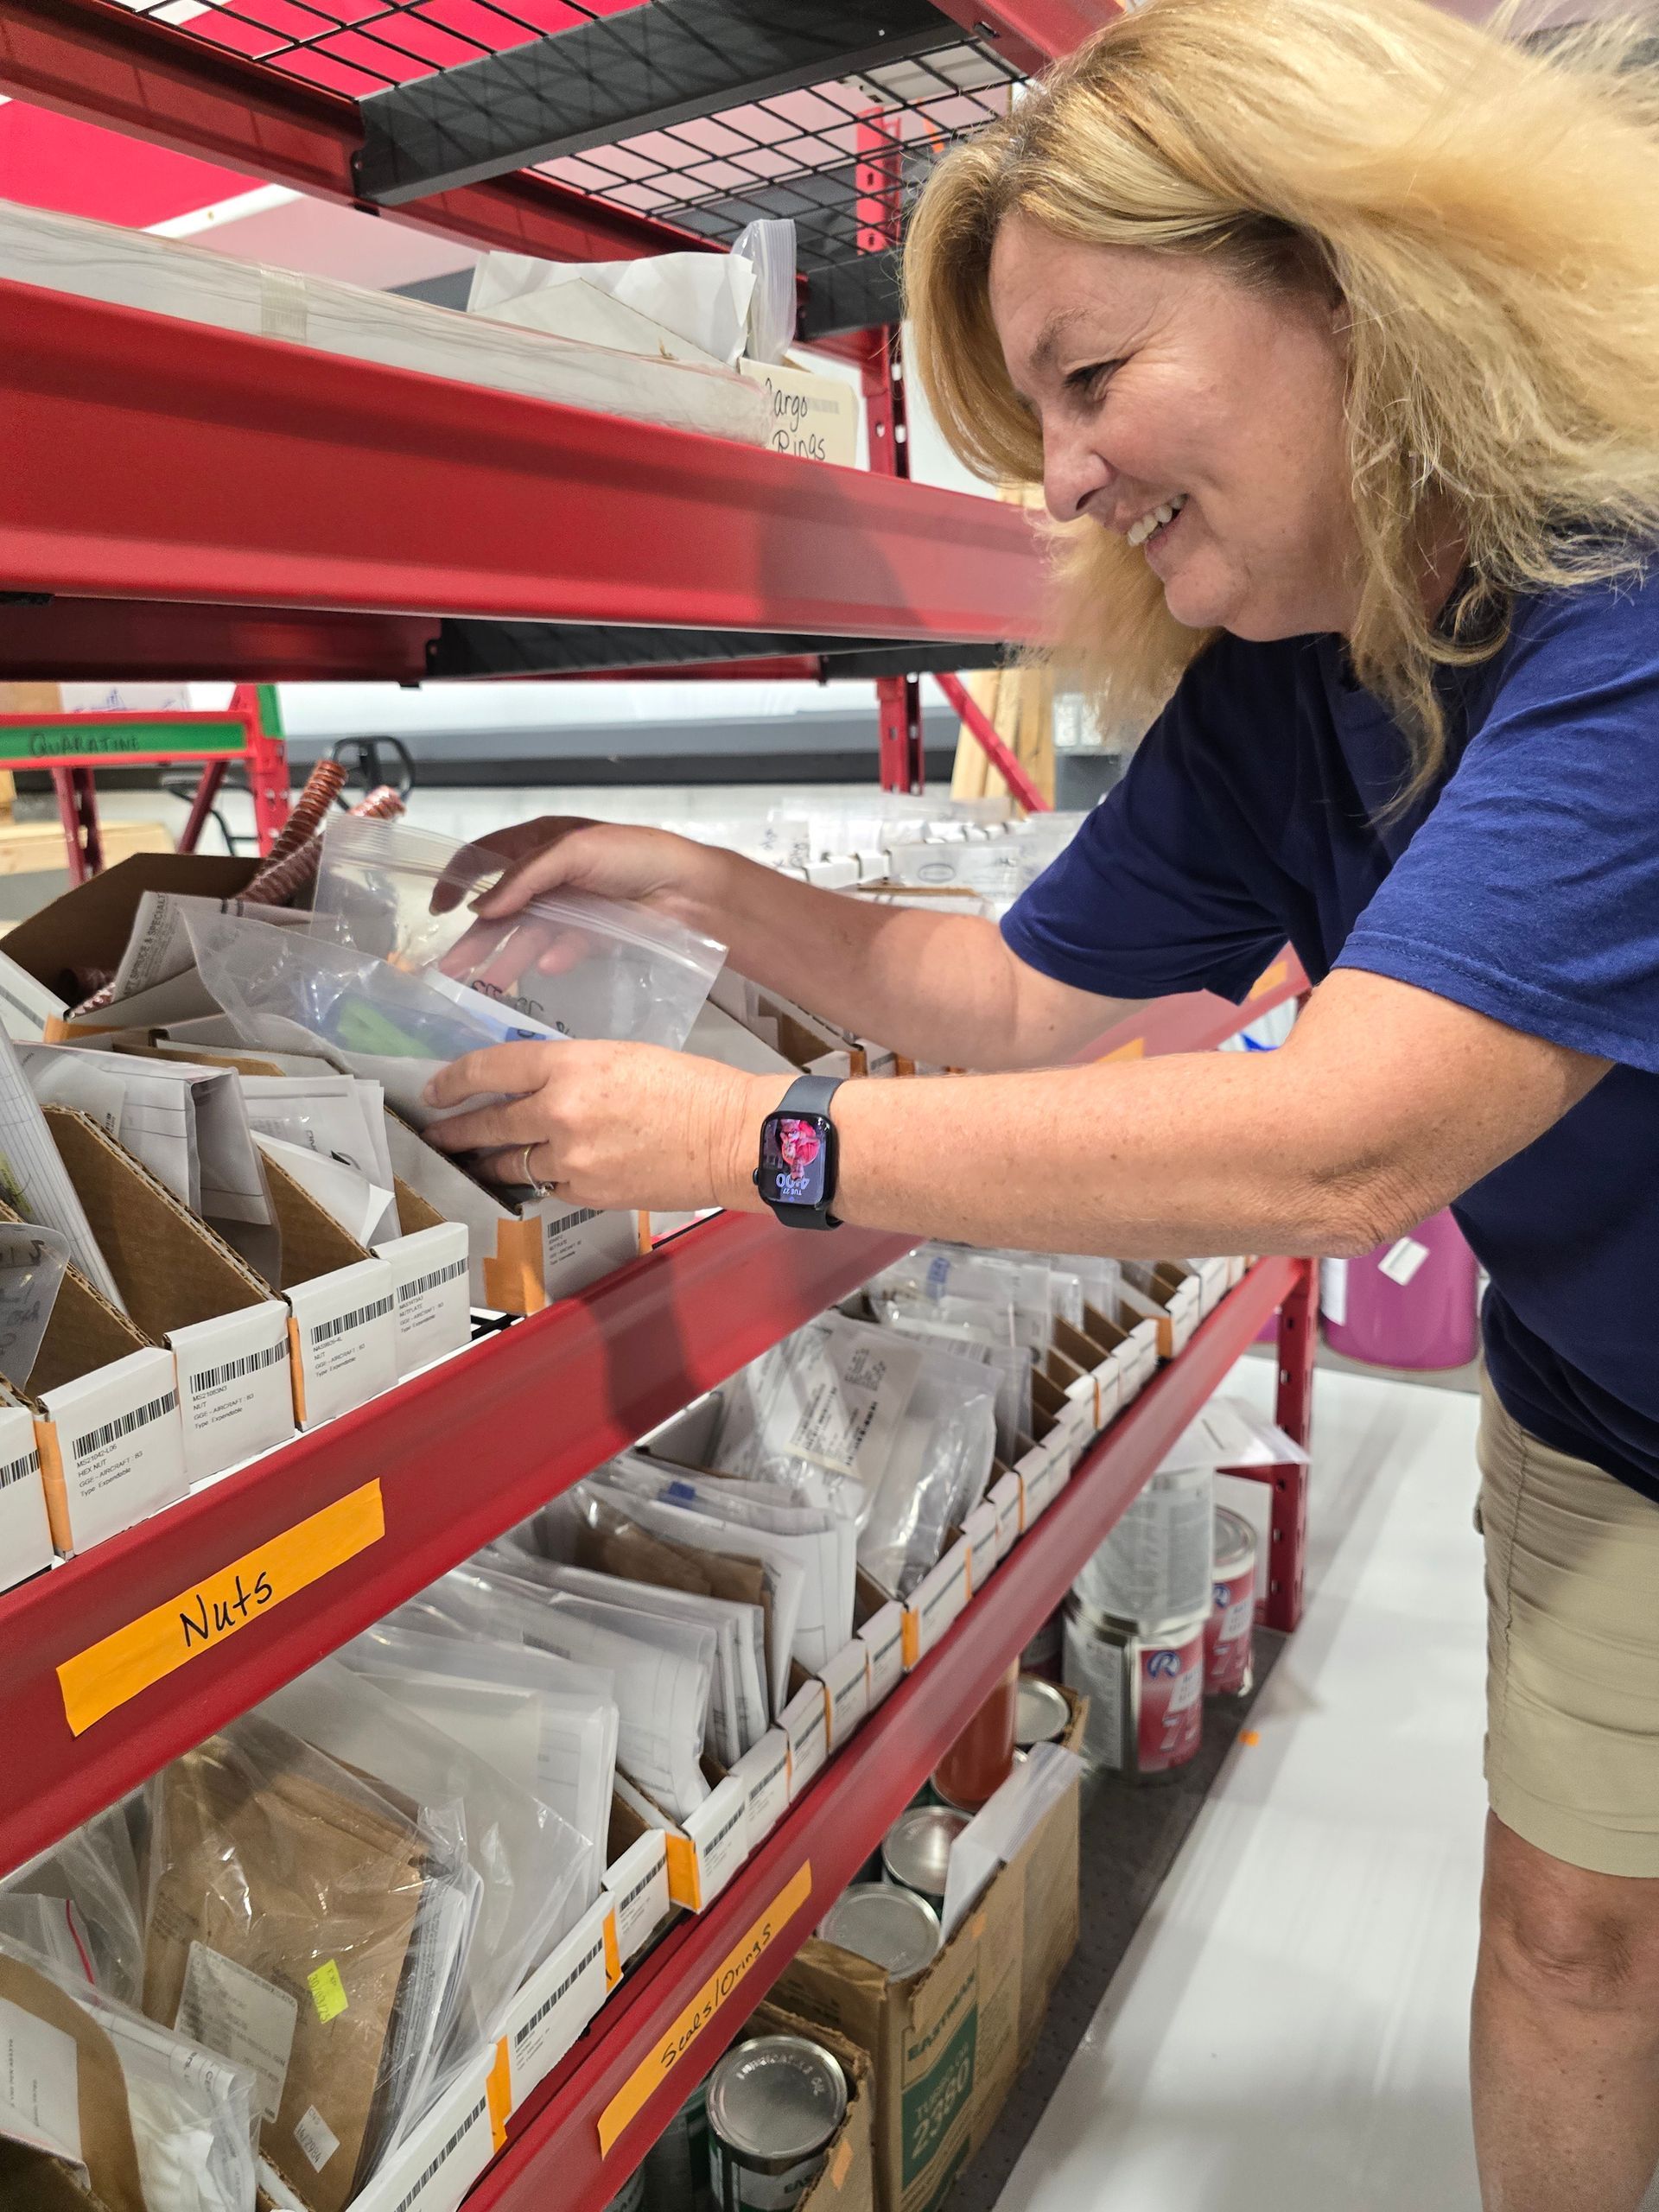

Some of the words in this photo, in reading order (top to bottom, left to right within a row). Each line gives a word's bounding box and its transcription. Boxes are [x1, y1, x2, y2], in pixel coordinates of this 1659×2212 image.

[314, 1351, 326, 1360] NUT
[193, 1402, 207, 1410] NUT
[78, 1467, 92, 1478] HEX
[93, 1459, 107, 1470] NUT
[179, 1571, 273, 1648] Nuts
[660, 1923, 772, 2069] Seals/Orings
